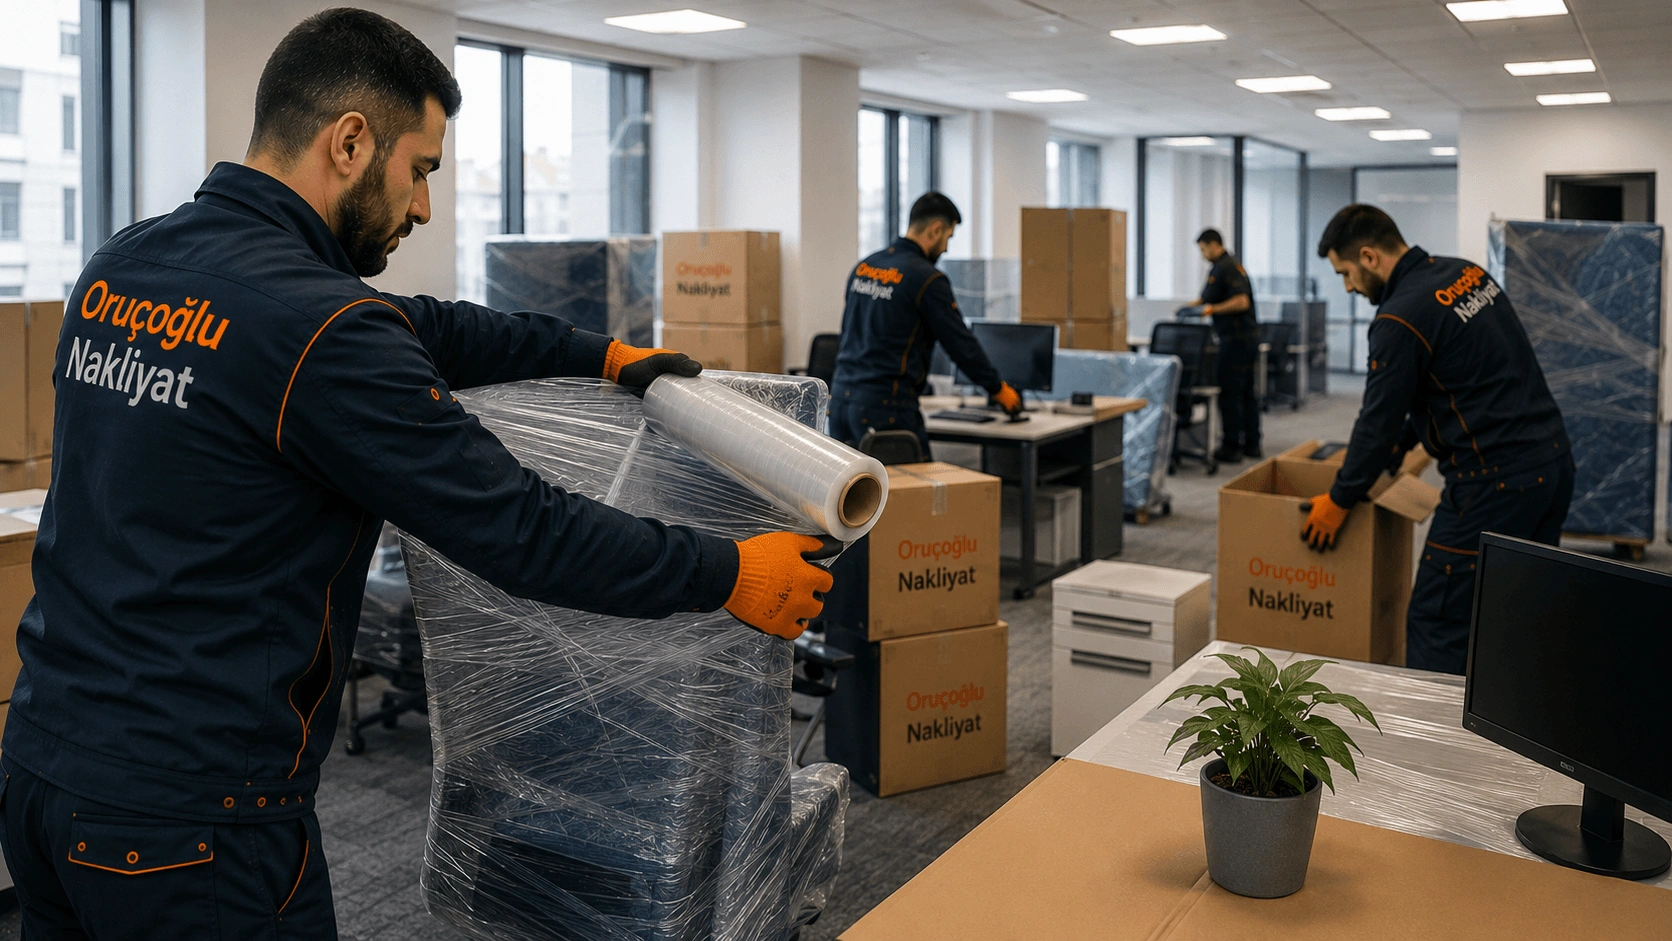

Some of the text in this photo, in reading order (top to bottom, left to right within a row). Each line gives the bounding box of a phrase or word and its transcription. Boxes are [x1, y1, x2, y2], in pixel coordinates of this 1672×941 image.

[677, 282, 731, 299] Nakliyat
[851, 278, 894, 300] Nakliyat
[1453, 279, 1500, 323] Nakliyat
[81, 280, 231, 350] Oruçoğlu
[65, 336, 194, 409] Nakliyat
[898, 534, 977, 561] Oruçoğlu
[898, 566, 976, 592] Nakliyat
[1249, 557, 1335, 590] Oruçoğlu
[1249, 587, 1334, 620] Nakliyat
[907, 682, 984, 711] Oruçoğlu
[907, 714, 982, 743] Nakliyat
